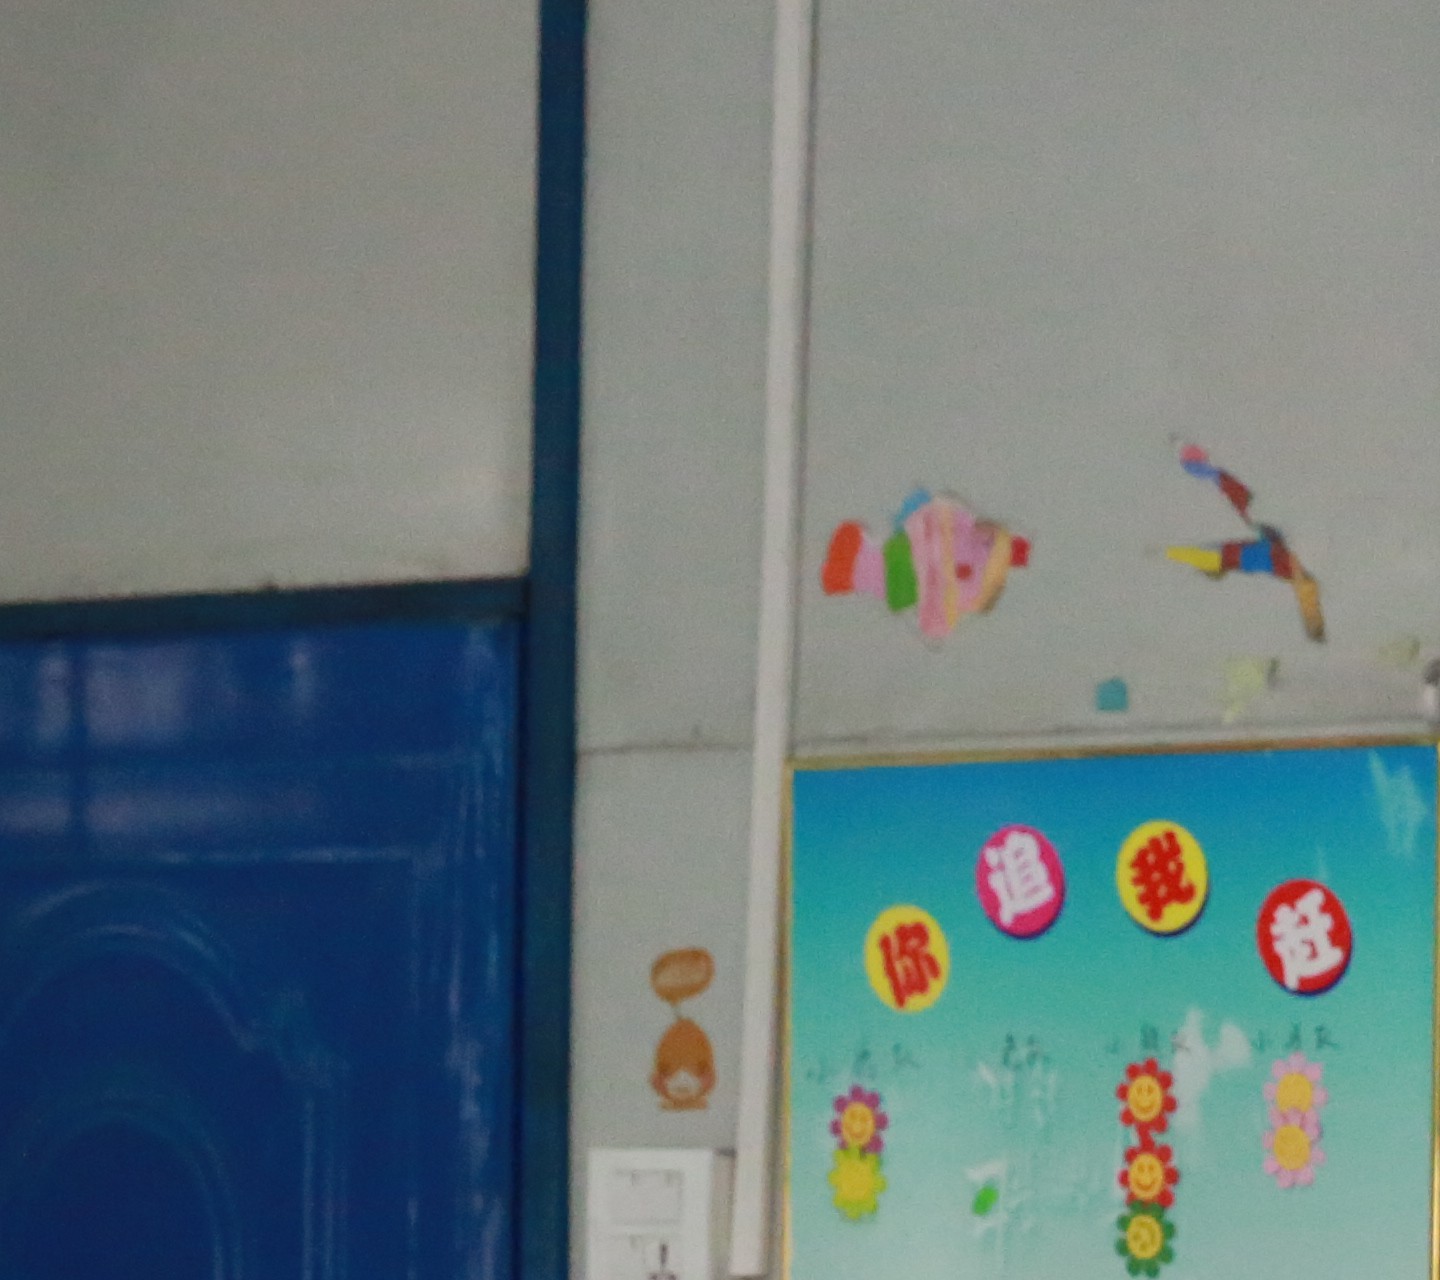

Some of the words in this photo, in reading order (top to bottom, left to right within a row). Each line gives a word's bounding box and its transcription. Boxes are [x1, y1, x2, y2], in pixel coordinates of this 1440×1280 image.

[877, 920, 943, 1009] 你
[983, 830, 1056, 928] 追
[1129, 829, 1197, 923] 我
[1270, 887, 1344, 990] 赶
